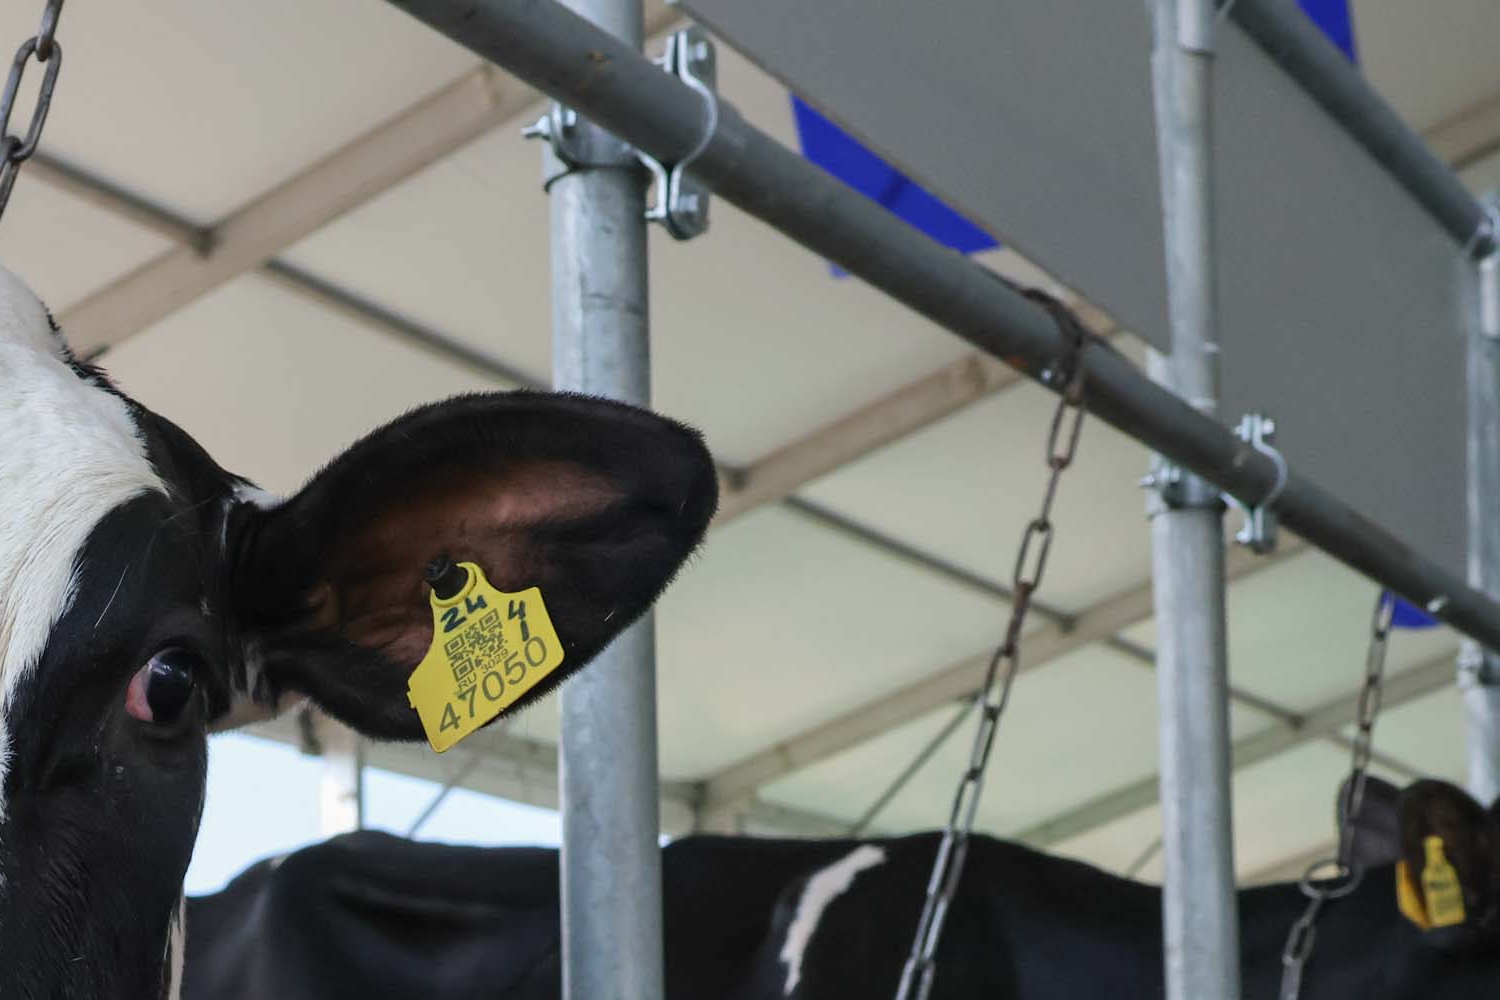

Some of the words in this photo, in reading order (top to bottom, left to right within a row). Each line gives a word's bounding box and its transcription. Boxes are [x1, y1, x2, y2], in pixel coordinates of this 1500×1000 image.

[440, 595, 488, 633] 24
[439, 636, 548, 733] 47050
[458, 672, 477, 692] RU
[481, 648, 508, 674] 3029
